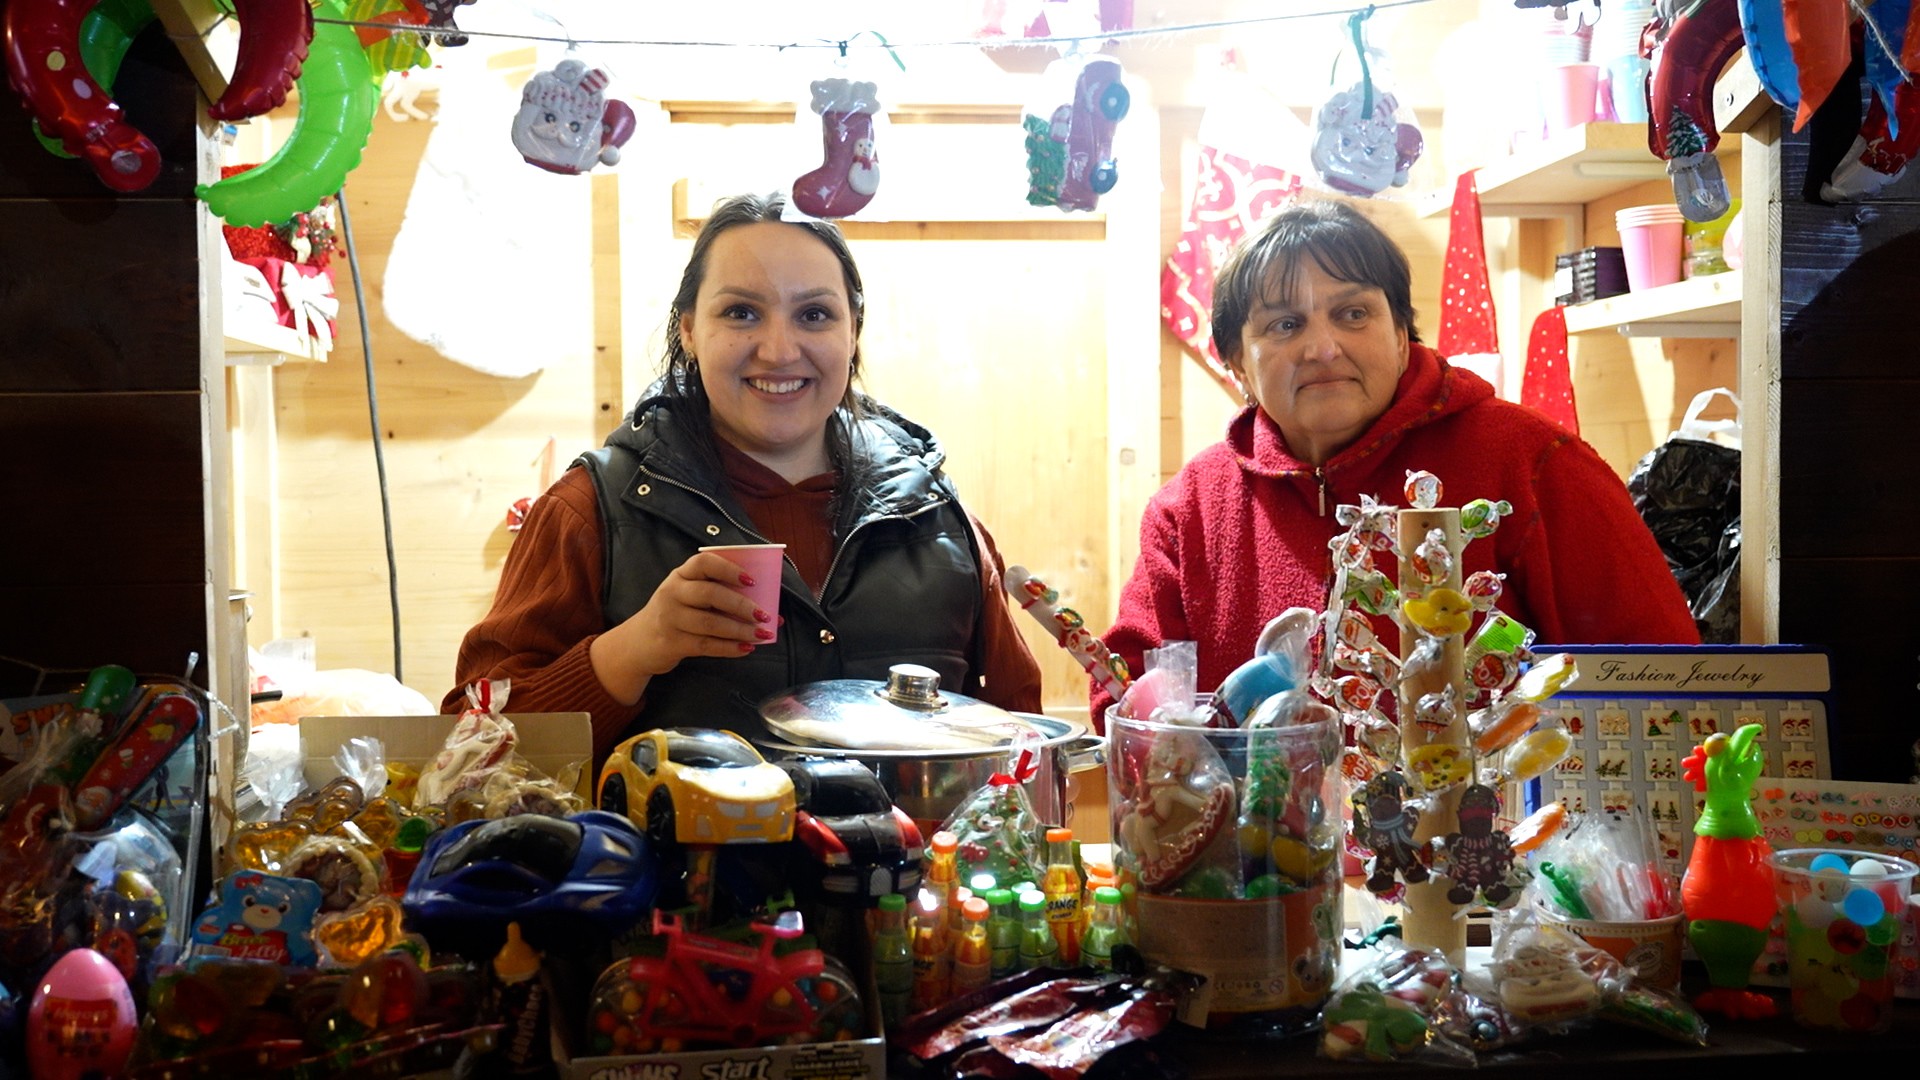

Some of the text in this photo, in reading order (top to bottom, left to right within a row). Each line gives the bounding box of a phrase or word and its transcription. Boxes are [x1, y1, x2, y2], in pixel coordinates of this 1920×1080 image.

[1596, 660, 1766, 689] Fashion Jewelry
[239, 943, 289, 962] Jelly
